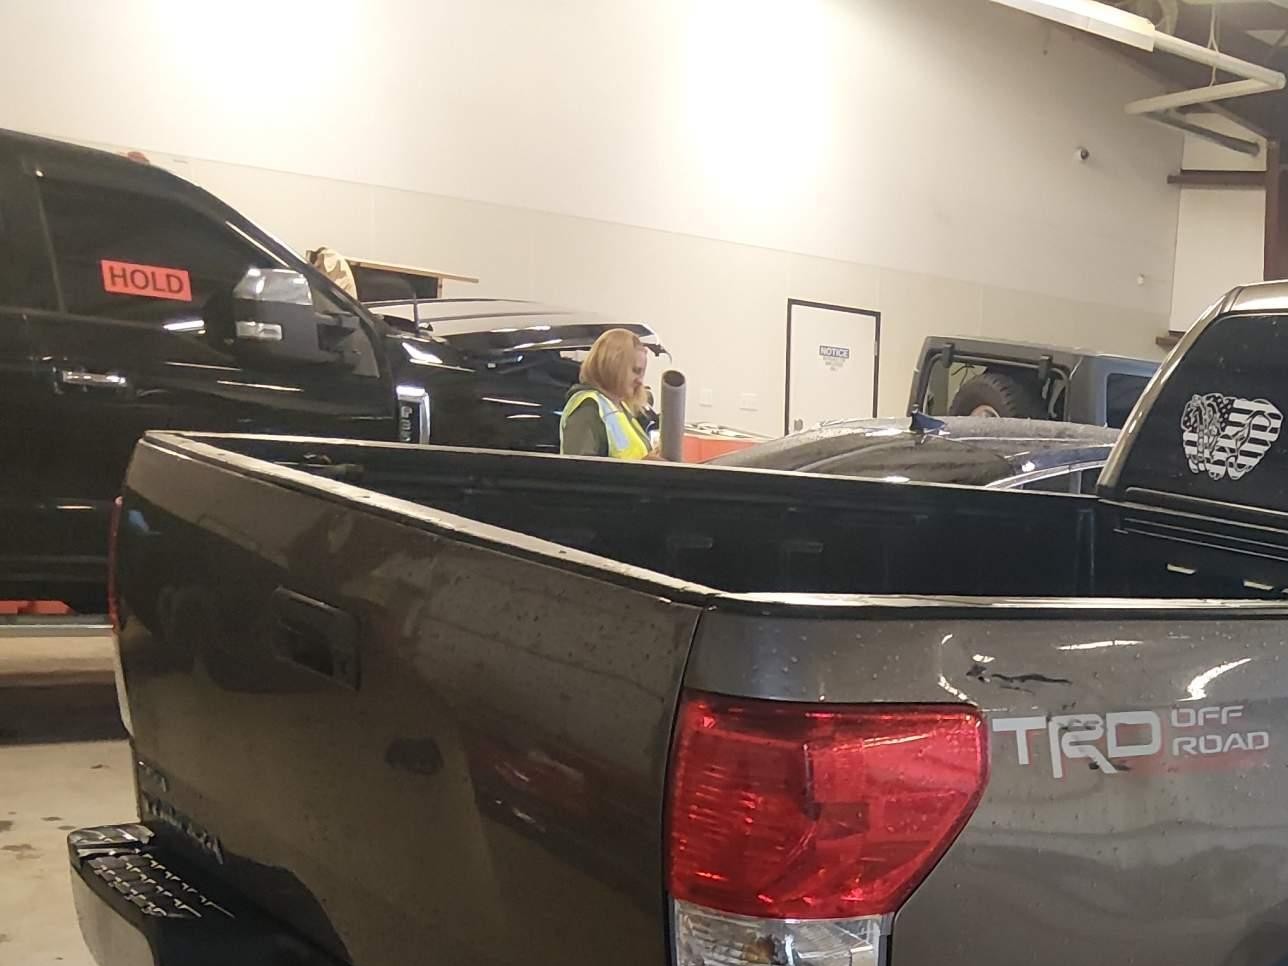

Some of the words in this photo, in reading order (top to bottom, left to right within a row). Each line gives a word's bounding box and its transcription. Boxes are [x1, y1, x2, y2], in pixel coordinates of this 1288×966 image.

[109, 266, 184, 294] HOLD
[1171, 705, 1245, 728] OFF
[992, 710, 1162, 779] TRD
[1172, 731, 1270, 757] ROAD
